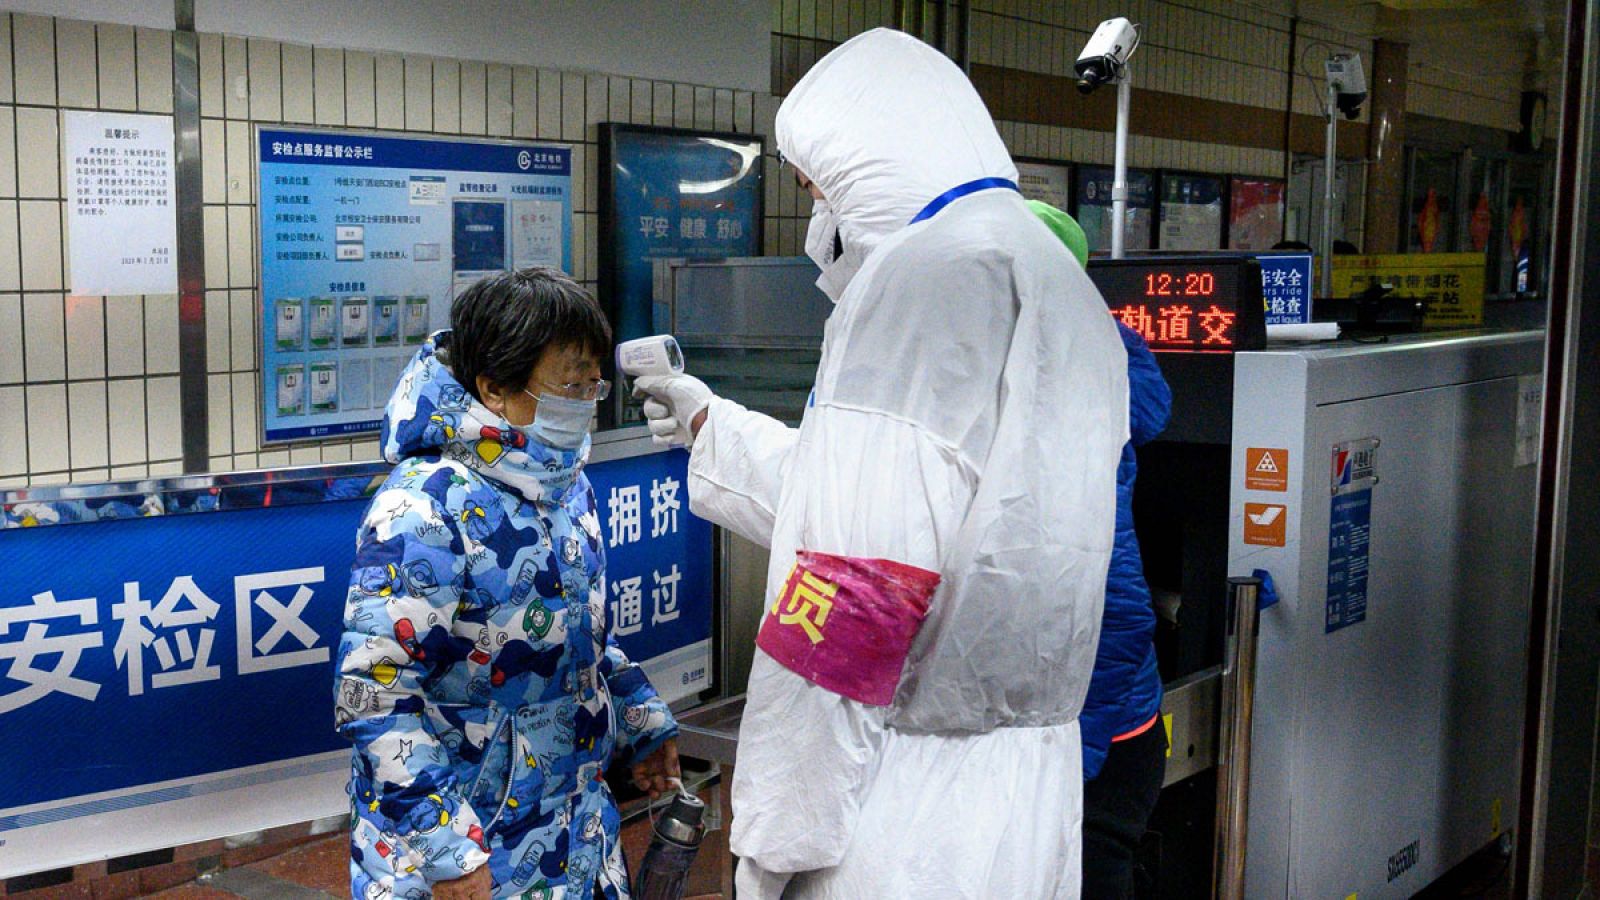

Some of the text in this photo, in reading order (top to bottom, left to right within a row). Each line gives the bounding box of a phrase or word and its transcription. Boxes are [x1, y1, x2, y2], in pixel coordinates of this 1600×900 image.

[105, 128, 139, 139] 温馨提示
[271, 140, 374, 160] 安检点服务监督公示栏
[639, 215, 743, 240] 平安 健康 舒心
[328, 281, 367, 293] 安检员信息
[1145, 272, 1215, 297] 12:20
[1281, 287, 1302, 295] ride
[1108, 304, 1237, 346] 轨道交
[607, 475, 681, 549] 拥挤
[609, 563, 682, 638] 通过
[771, 562, 841, 646] 员
[0, 566, 330, 714] 安检区
